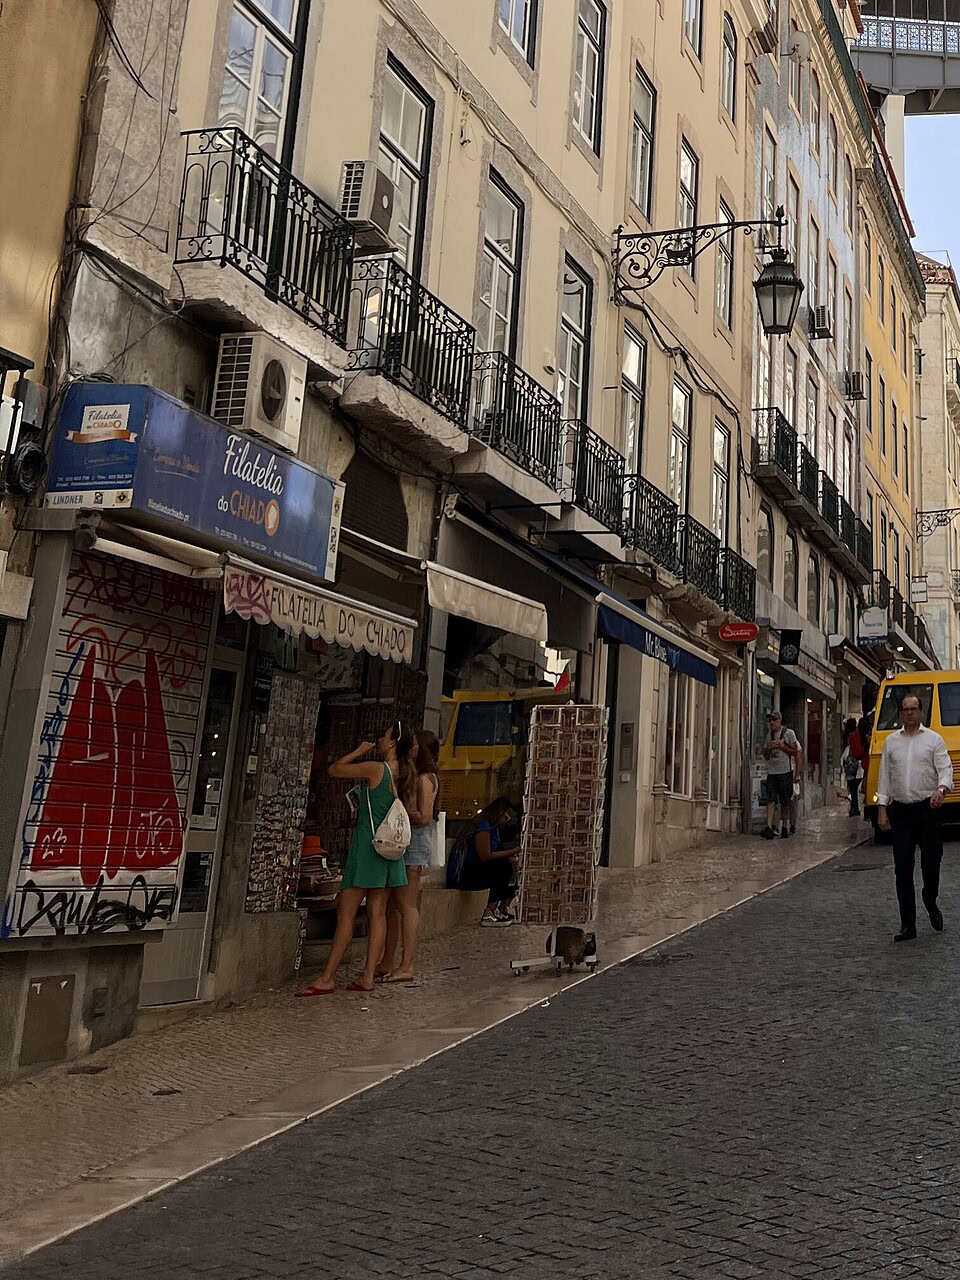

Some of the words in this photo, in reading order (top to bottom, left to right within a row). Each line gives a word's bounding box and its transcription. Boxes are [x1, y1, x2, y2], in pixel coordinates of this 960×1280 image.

[88, 410, 122, 421] Filatelia
[223, 434, 284, 496] Filatelia
[53, 494, 84, 505] LINDNER
[217, 495, 229, 512] do
[230, 489, 280, 537] CHIADO
[269, 587, 327, 630] FILATELIA
[338, 609, 356, 637] DO
[366, 619, 406, 654] CHIADO
